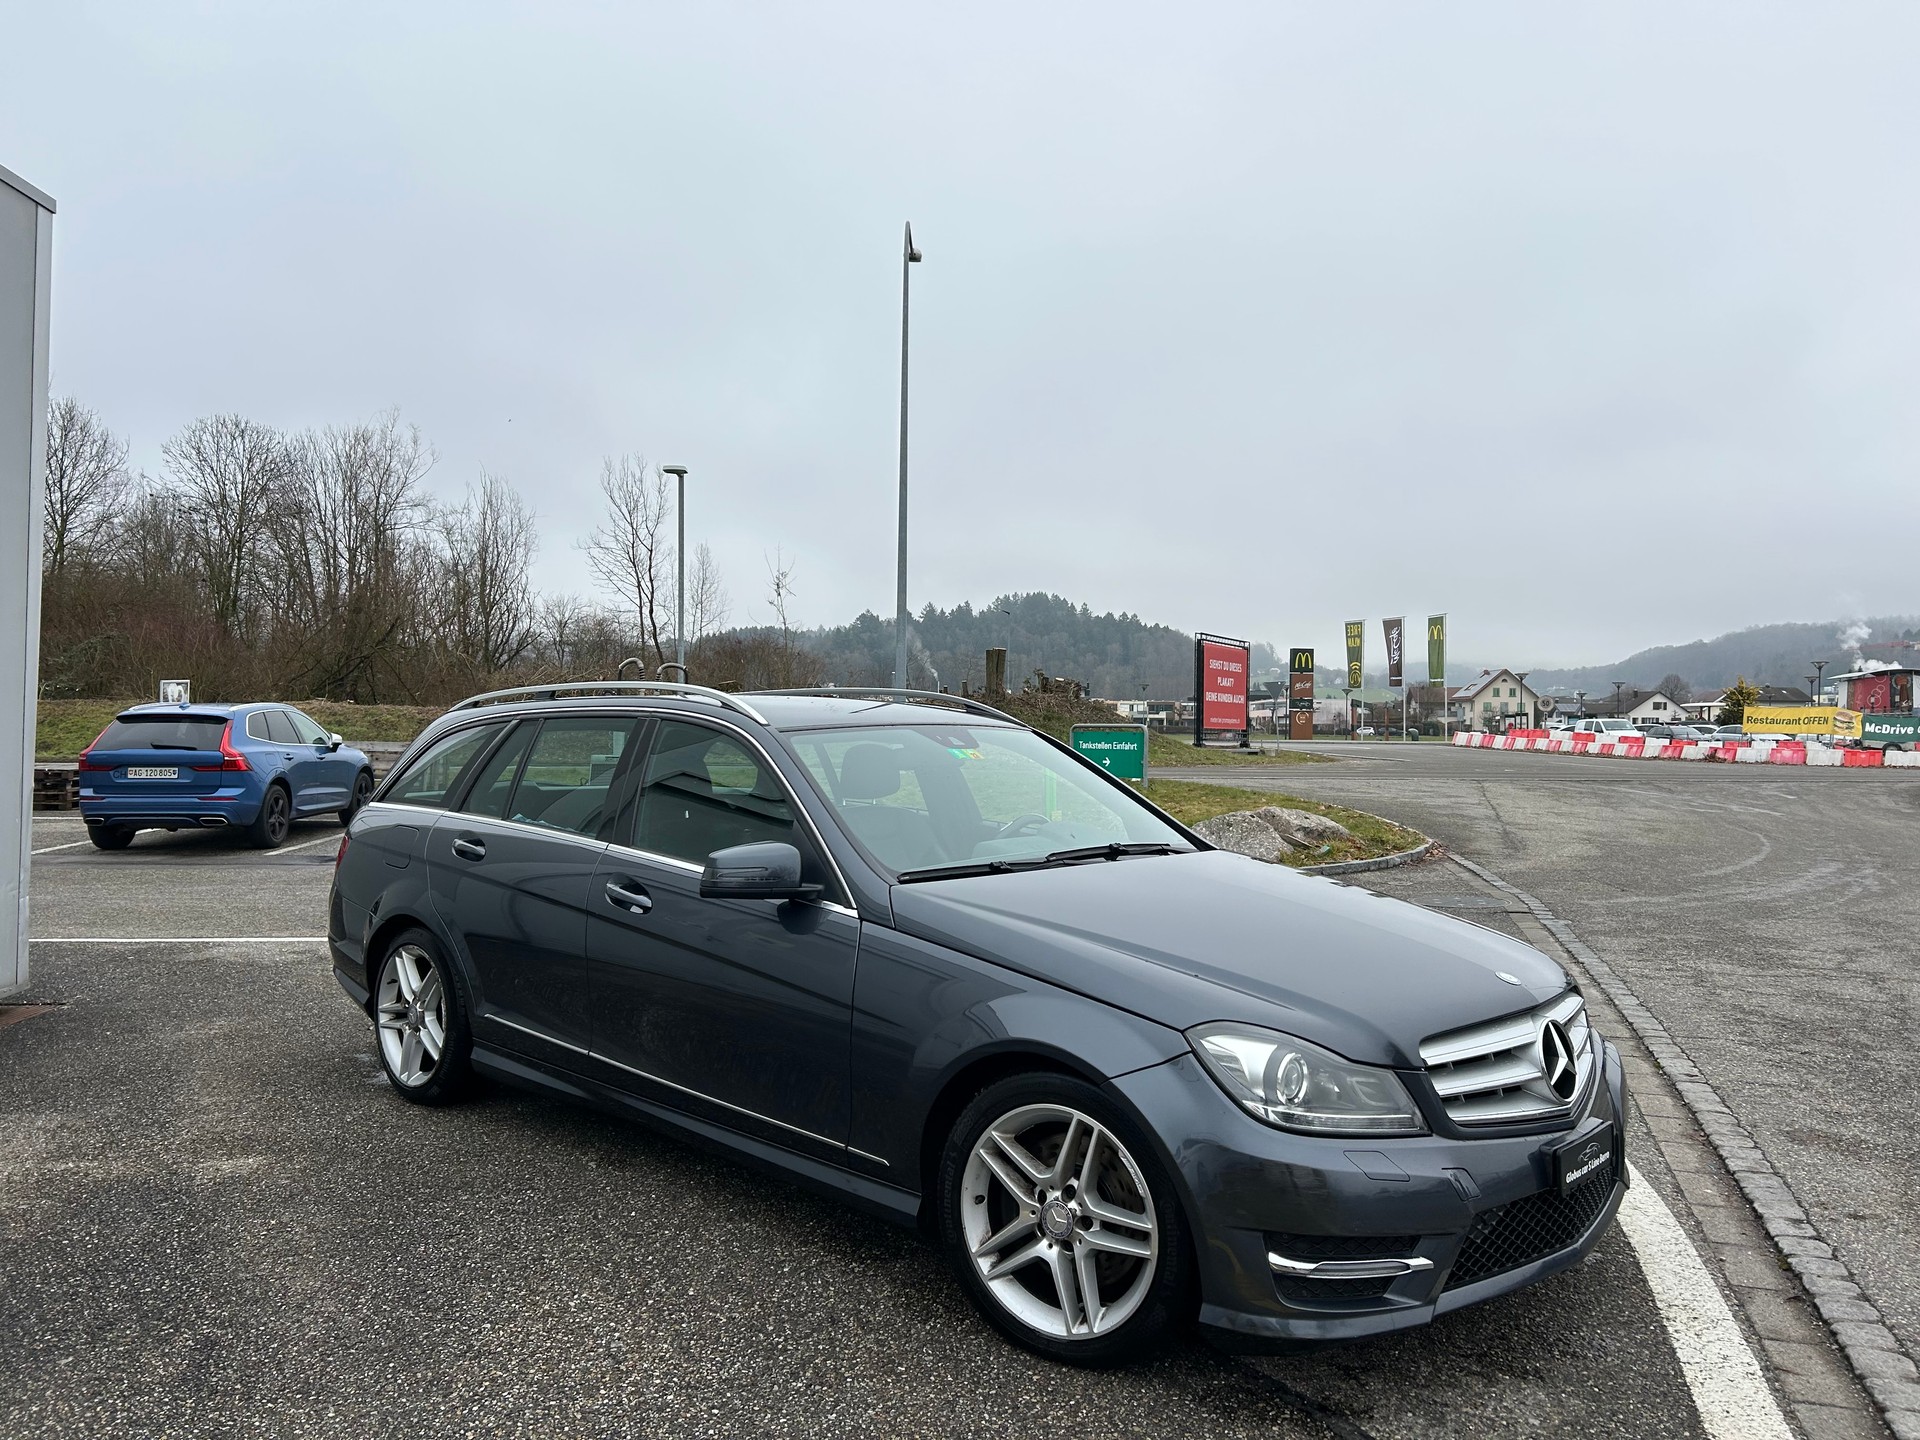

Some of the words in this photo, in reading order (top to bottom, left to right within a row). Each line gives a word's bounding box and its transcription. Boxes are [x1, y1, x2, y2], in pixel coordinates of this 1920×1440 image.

[1229, 662, 1242, 673] DIESES
[1217, 676, 1234, 688] PLAKAT?
[1206, 692, 1217, 702] DEINE
[1218, 693, 1233, 703] KUNDEN
[1746, 715, 1802, 726] Restaurant
[1803, 716, 1829, 725] OFFEN
[1865, 722, 1914, 735] McDrive
[1079, 741, 1112, 750] Tankstellen
[1113, 742, 1138, 750] Einfahrt
[113, 770, 127, 779] CH
